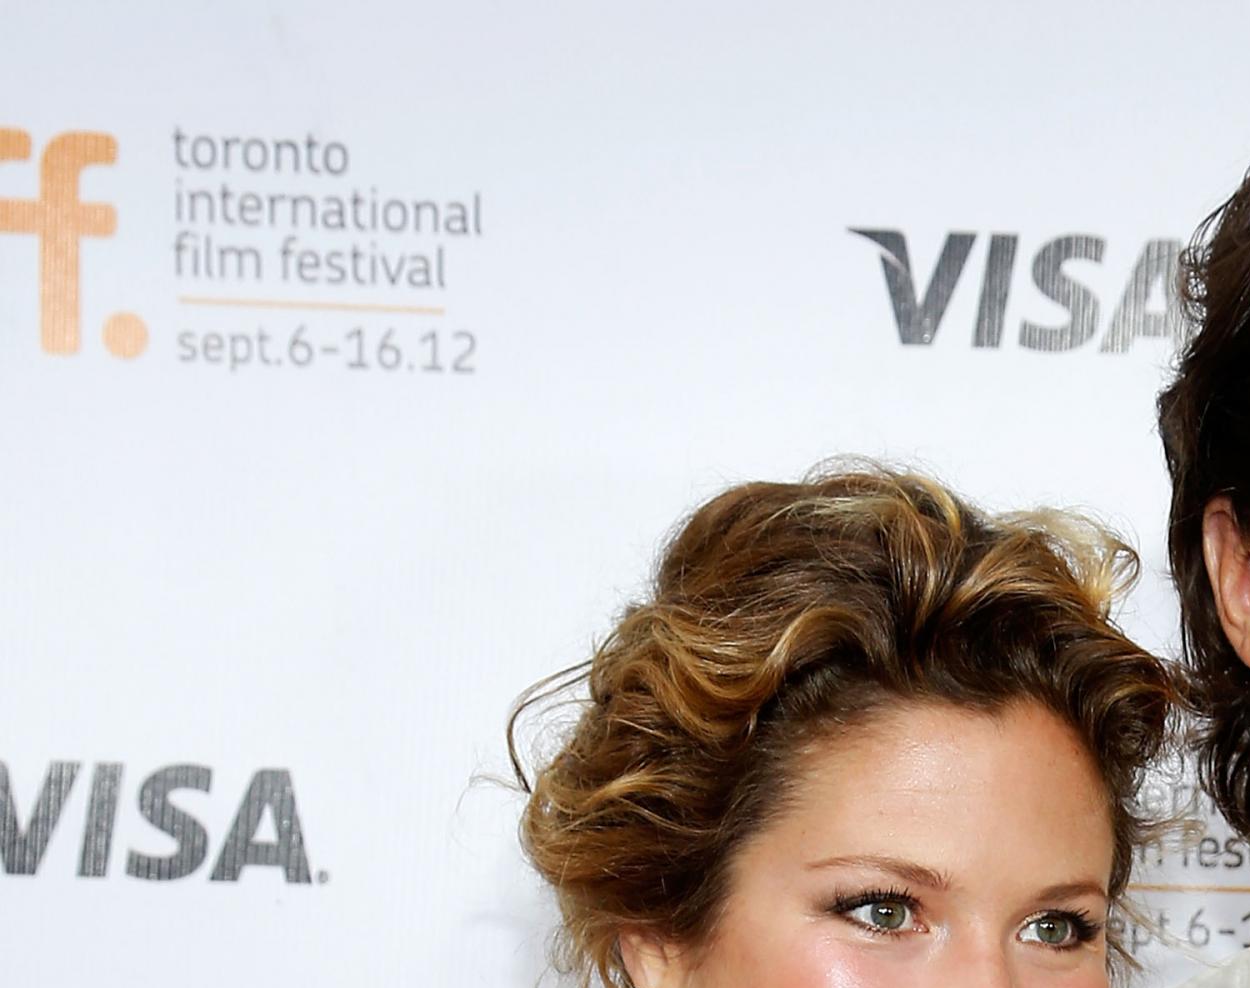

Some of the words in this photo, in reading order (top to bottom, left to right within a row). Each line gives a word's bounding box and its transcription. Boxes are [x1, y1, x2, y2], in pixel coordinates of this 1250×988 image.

[171, 126, 350, 177] toronto
[174, 178, 482, 238] international
[173, 229, 263, 280] film
[280, 234, 447, 289] festival
[846, 227, 1178, 353] VISA
[177, 324, 477, 374] sept.6-16.12
